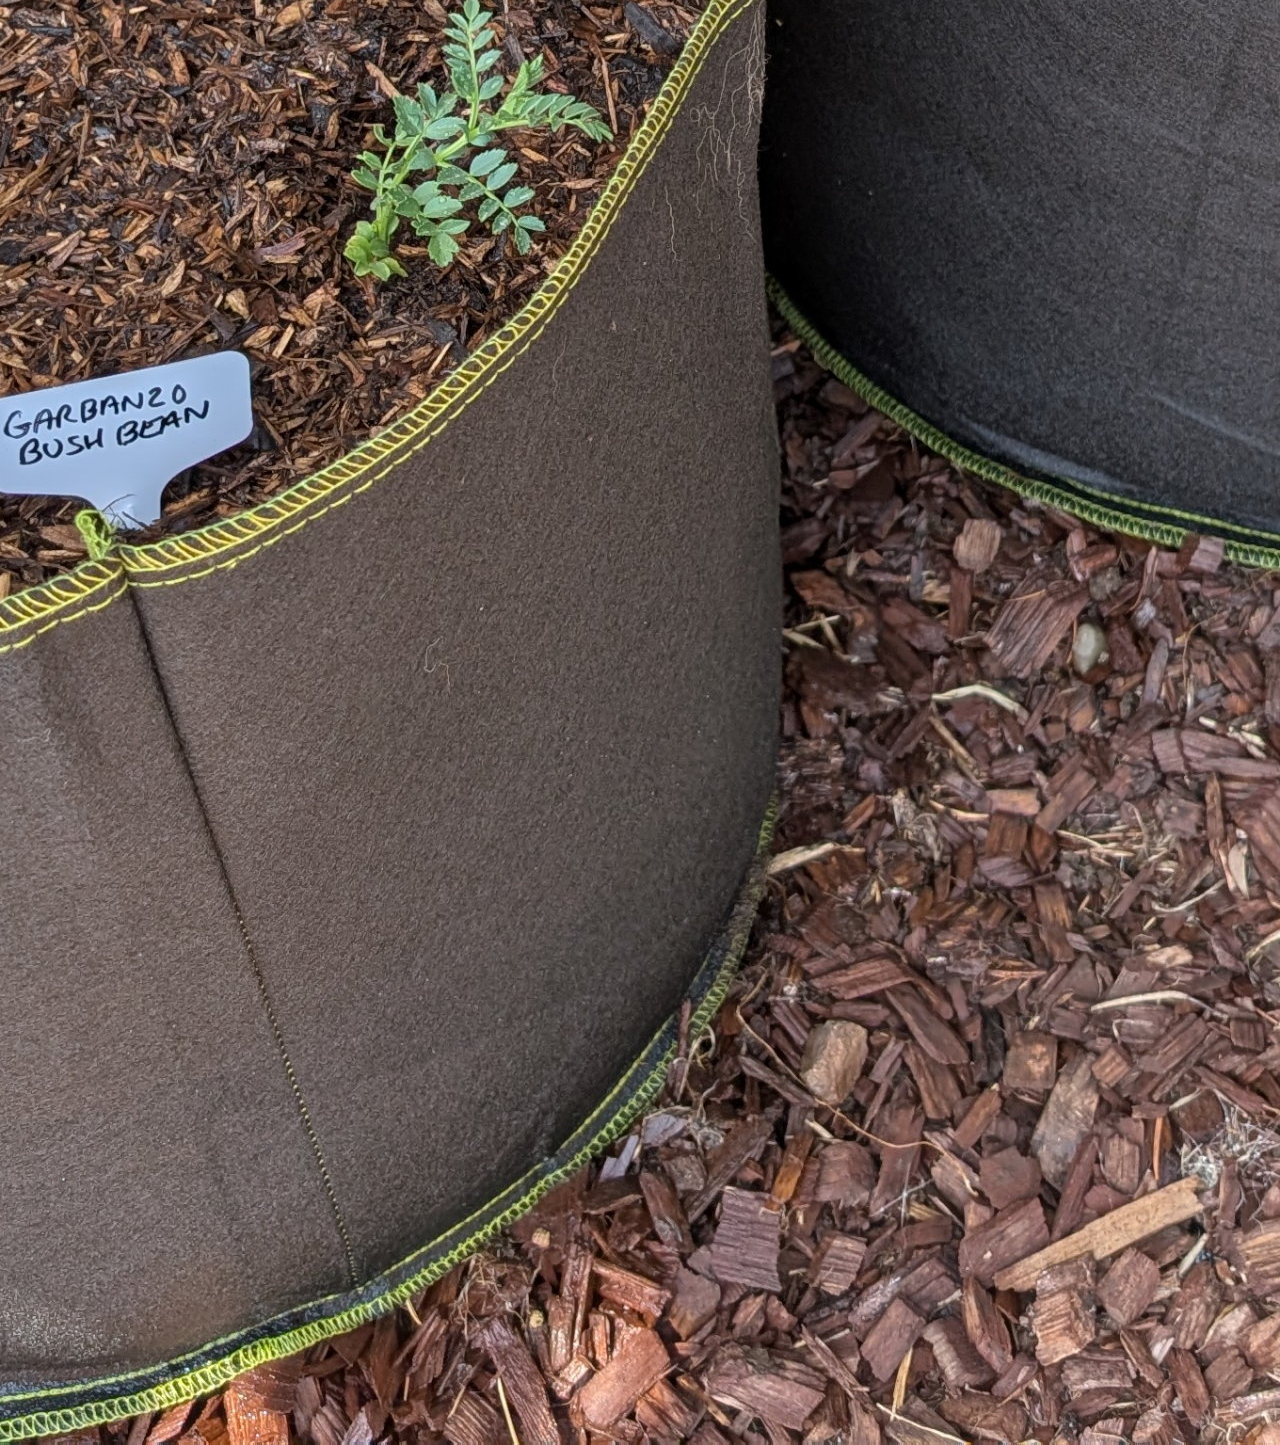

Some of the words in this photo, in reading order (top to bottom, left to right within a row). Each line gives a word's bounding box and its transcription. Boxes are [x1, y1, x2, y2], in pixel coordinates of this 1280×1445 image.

[3, 383, 187, 439] GARBANZO
[18, 428, 104, 466] BUSH
[115, 399, 210, 446] BEAN
